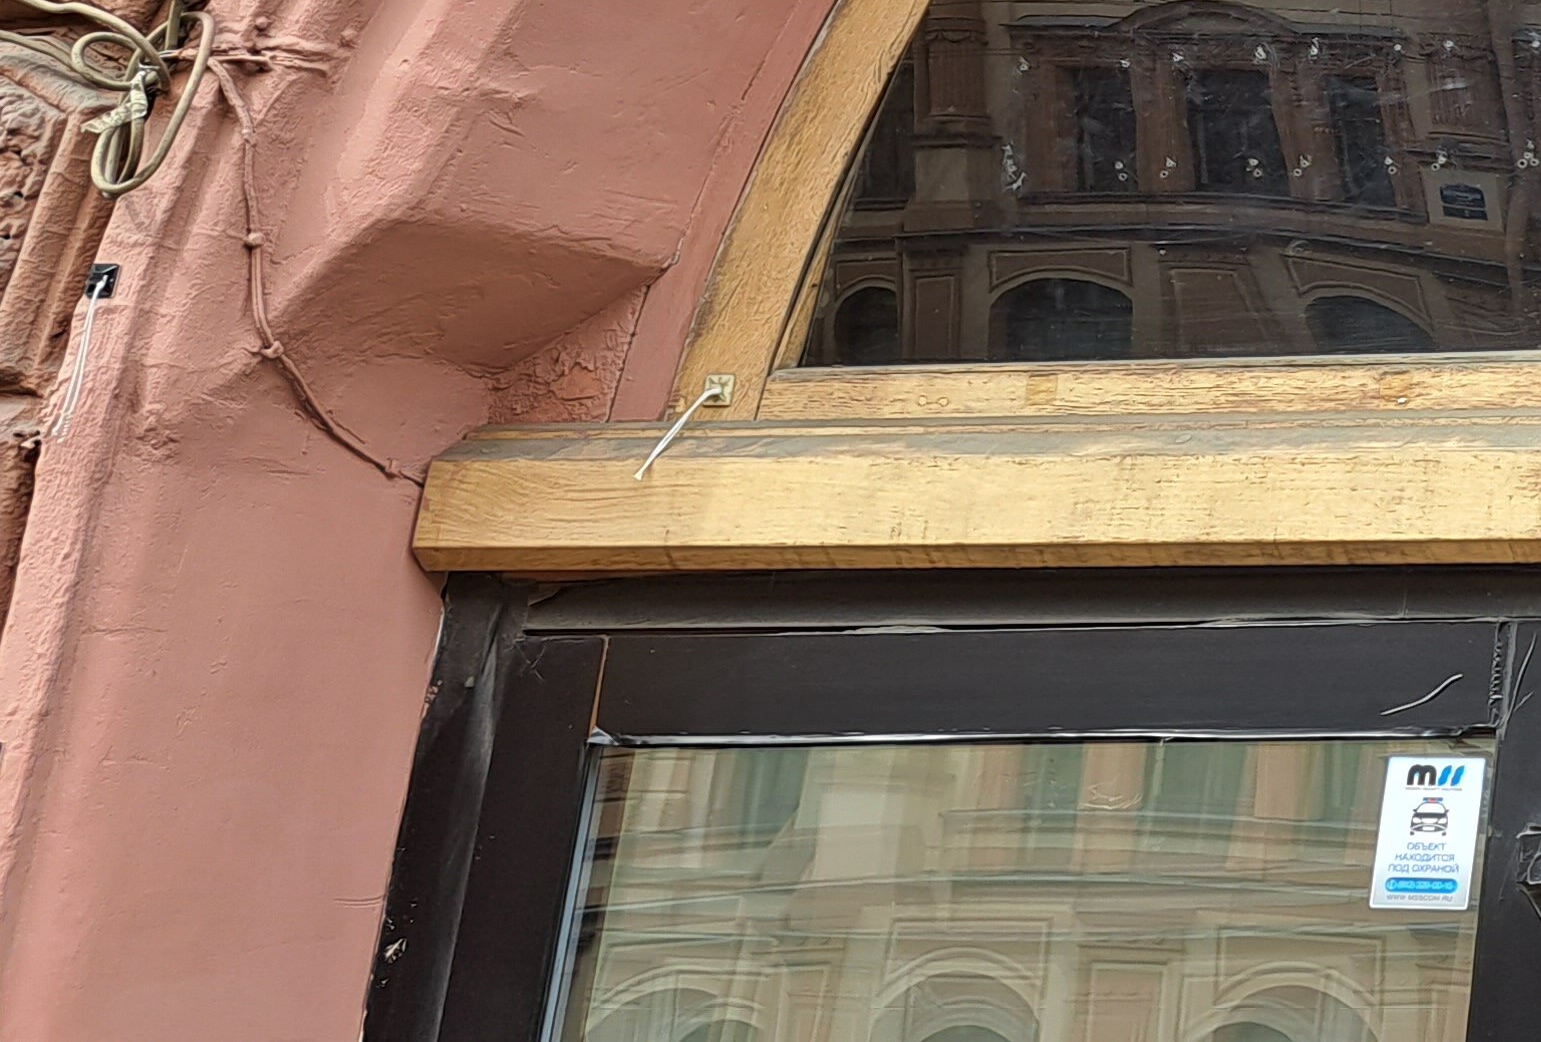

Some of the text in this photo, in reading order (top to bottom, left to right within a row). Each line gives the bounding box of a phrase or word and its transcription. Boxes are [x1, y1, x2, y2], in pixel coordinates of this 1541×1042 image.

[1406, 841, 1447, 851] ОБЪЕКТ
[1394, 852, 1456, 862] НАХОДИТСЯ
[1388, 863, 1460, 874] ПОД ОХРАНОЙ
